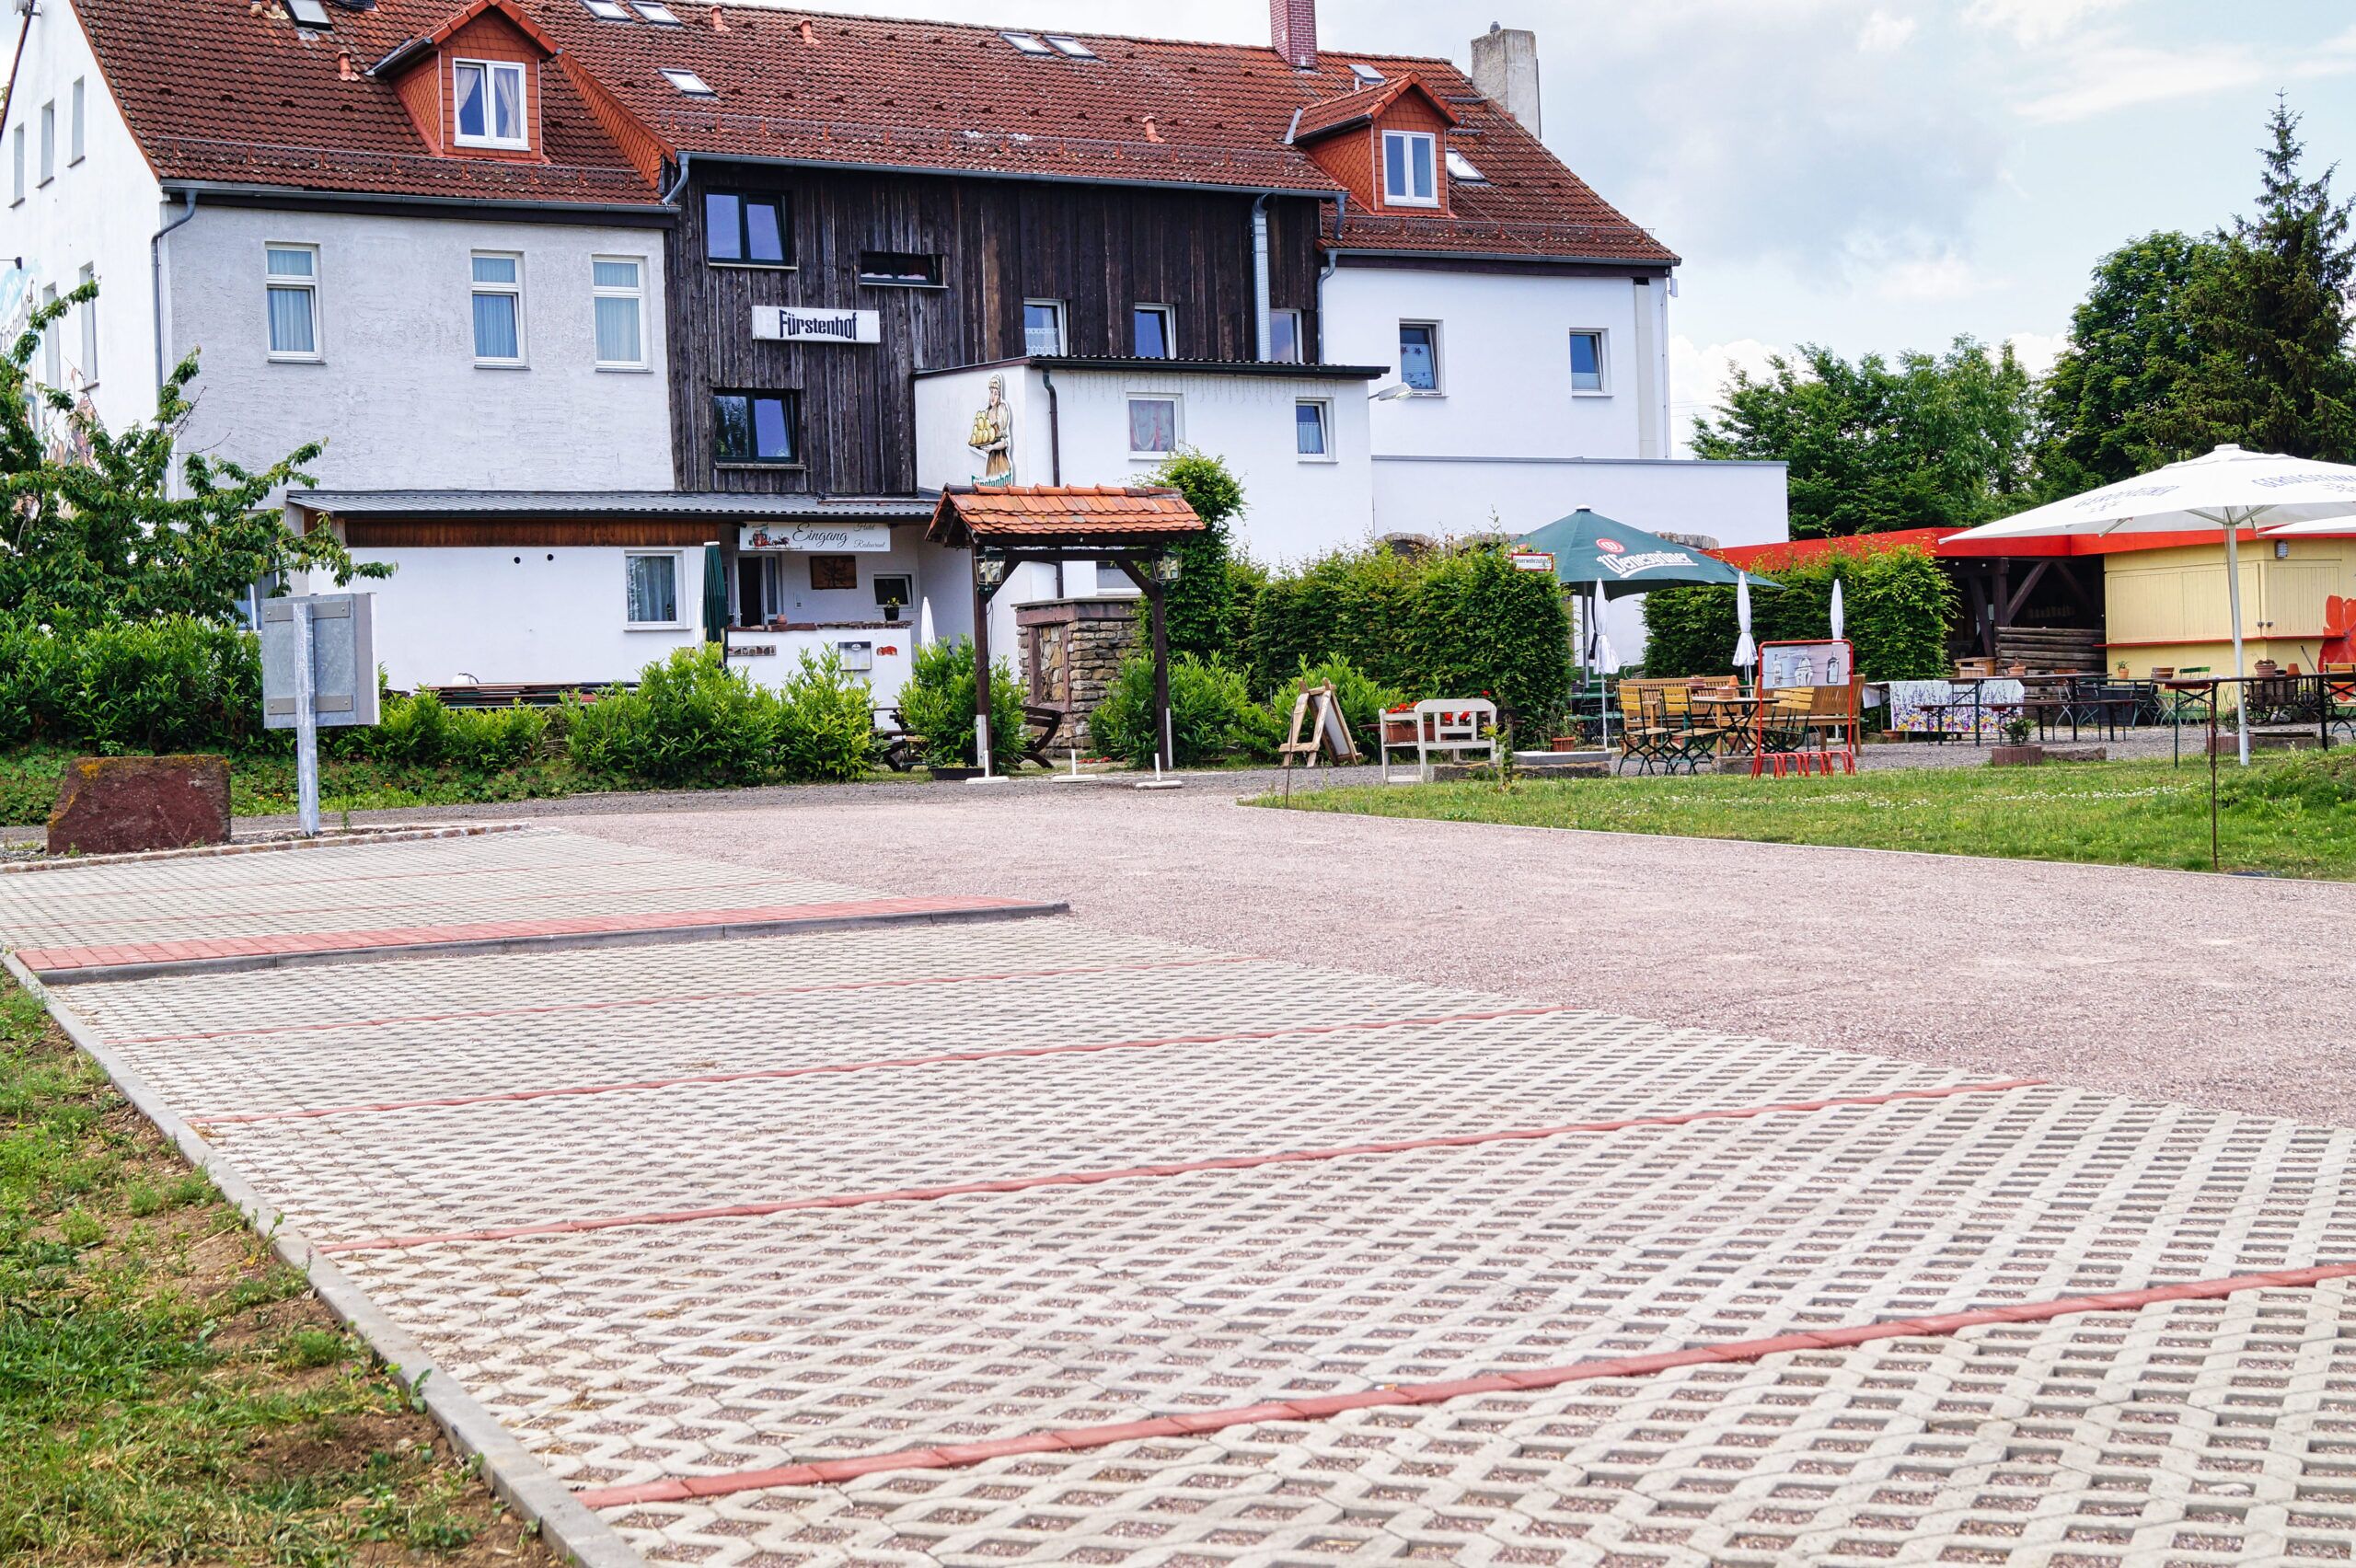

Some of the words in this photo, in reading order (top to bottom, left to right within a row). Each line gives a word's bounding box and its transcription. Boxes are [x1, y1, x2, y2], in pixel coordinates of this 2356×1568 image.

[780, 309, 857, 340] Fürstenhof
[792, 522, 848, 548] Eingang
[1596, 550, 1694, 575] Wernesgrüner
